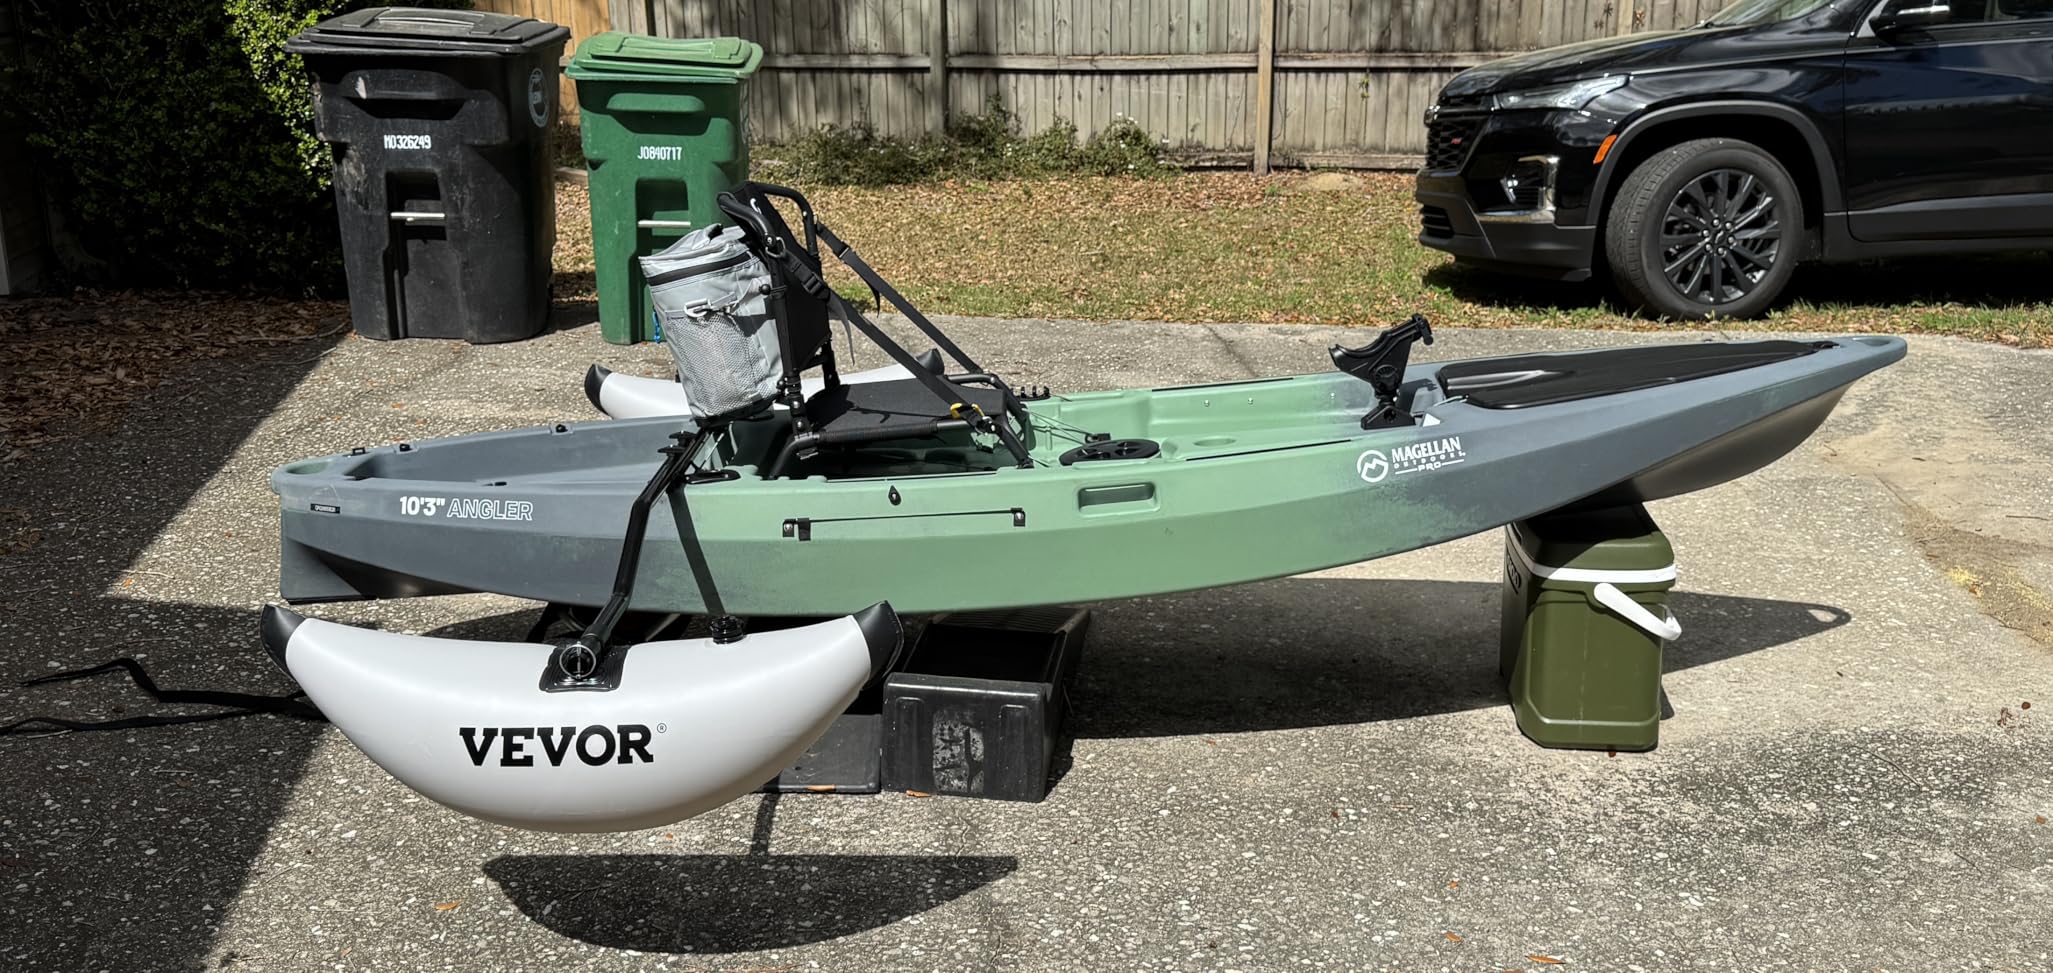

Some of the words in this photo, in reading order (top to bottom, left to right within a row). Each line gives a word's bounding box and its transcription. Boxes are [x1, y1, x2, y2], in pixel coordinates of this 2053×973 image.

[637, 145, 682, 161] J0840717
[1391, 436, 1462, 464] MAGELLAN
[1417, 461, 1442, 473] PRO
[399, 495, 446, 517] 10'3"
[446, 498, 534, 521] ANGLER
